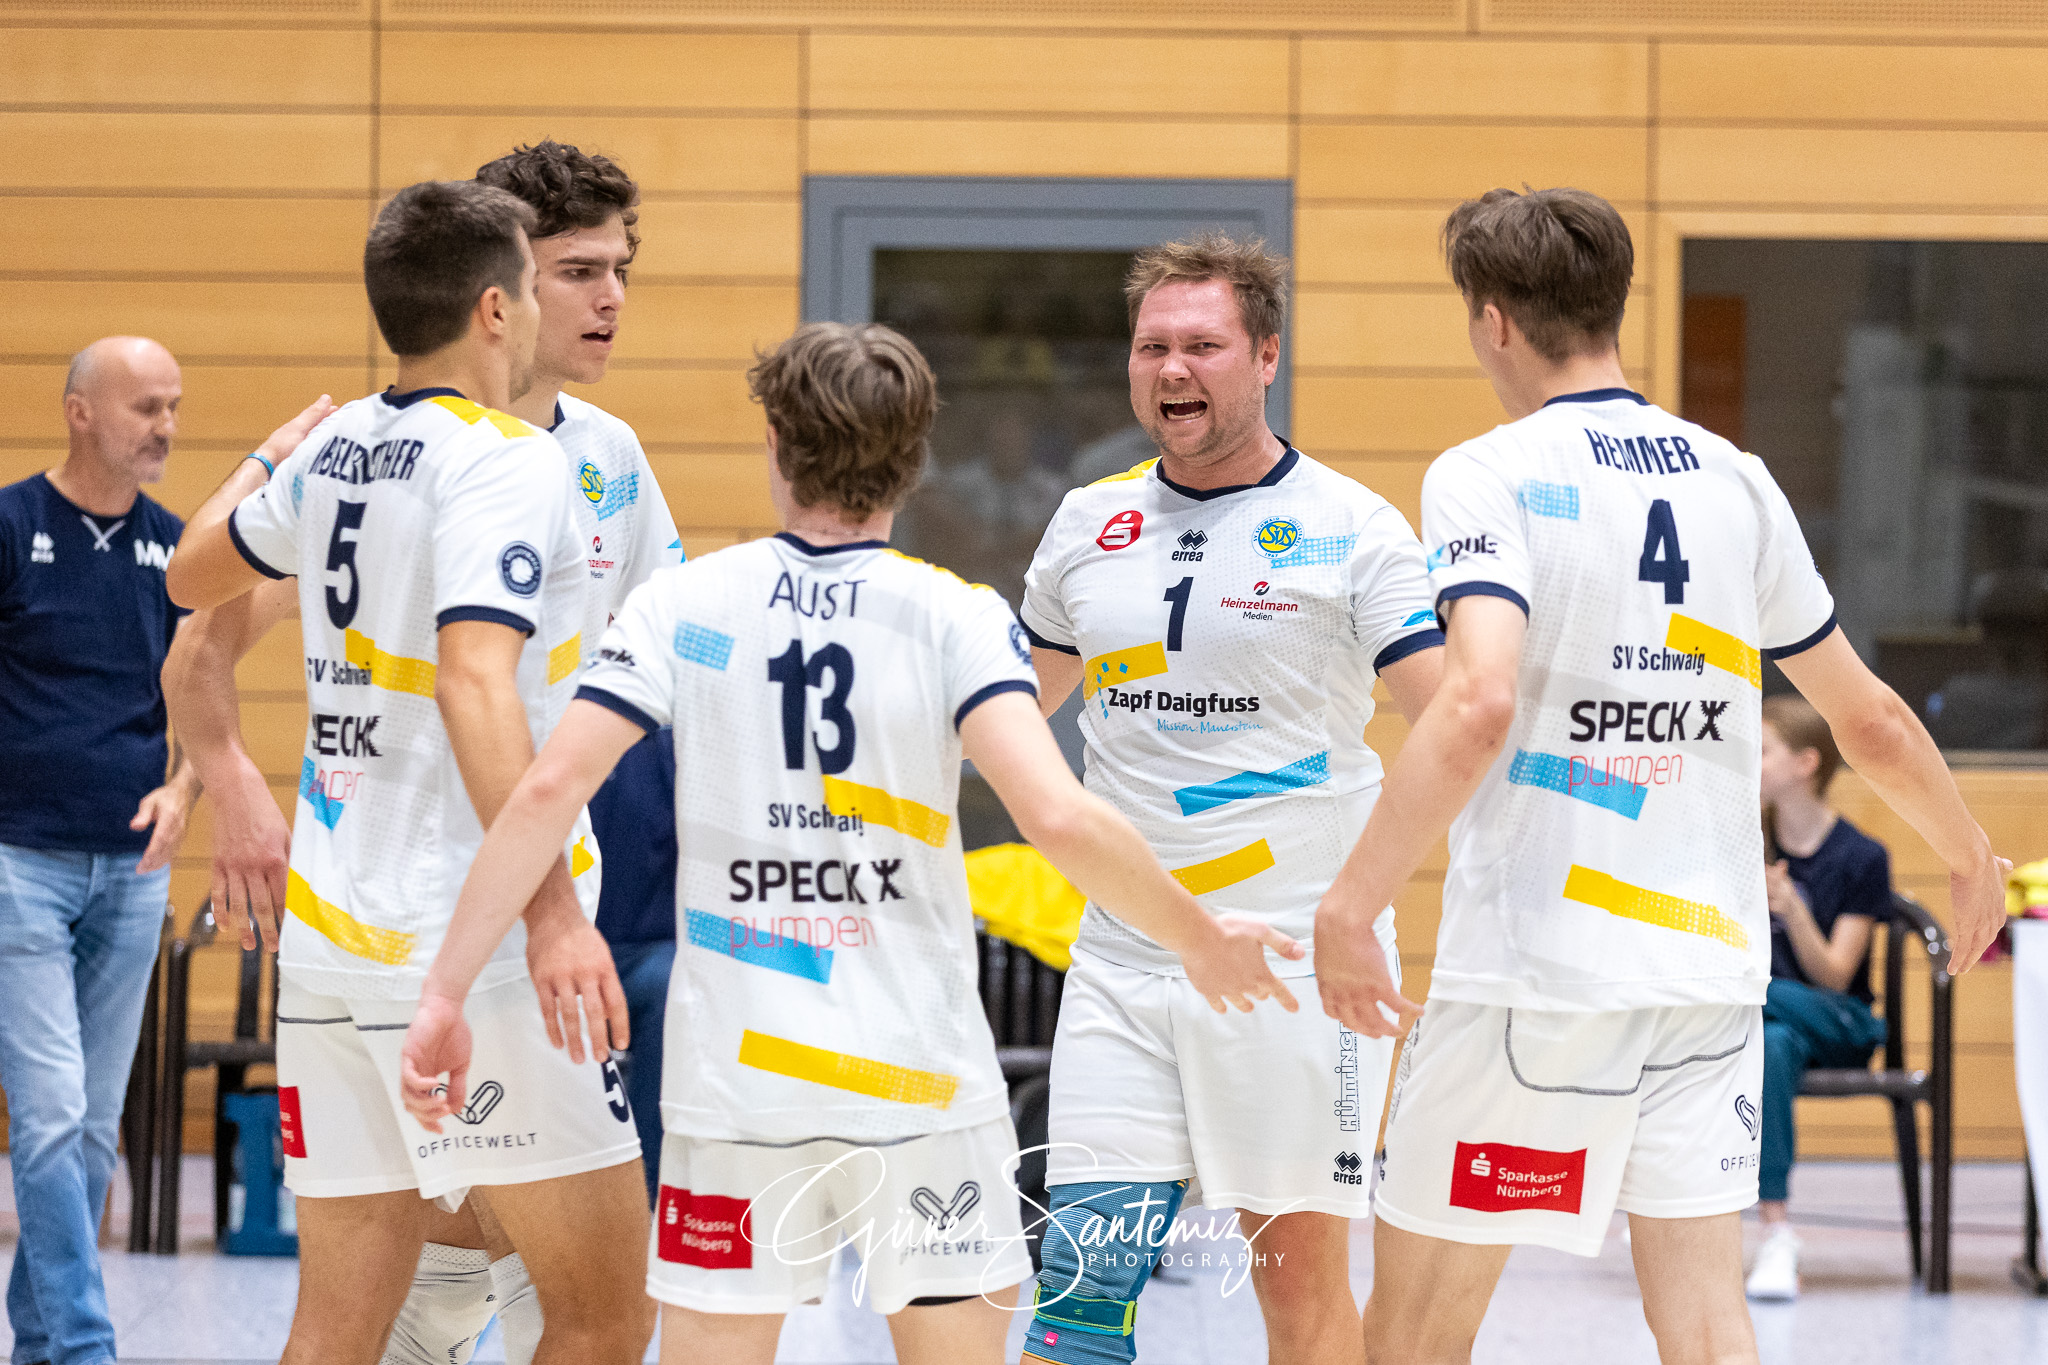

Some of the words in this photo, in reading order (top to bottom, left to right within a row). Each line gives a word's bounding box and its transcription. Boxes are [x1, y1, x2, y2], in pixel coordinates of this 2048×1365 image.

[1583, 428, 1701, 475] HEMMER
[324, 499, 367, 630] 5
[1171, 550, 1204, 562] errea
[1638, 499, 1690, 605] 4
[768, 571, 867, 620] AUST
[1220, 597, 1299, 612] Heinzelmann
[1163, 576, 1194, 652] 1
[1242, 611, 1273, 620] Medien
[1612, 645, 1634, 669] SV
[1638, 646, 1706, 676] Schwaig
[767, 638, 857, 775] 13
[1107, 688, 1153, 712] Zapf
[1157, 692, 1260, 717] Daigfuss
[1569, 700, 1691, 742] SPECK
[1569, 754, 1684, 796] pumpen
[768, 803, 792, 828] SV
[729, 859, 868, 904] SPECK
[730, 915, 877, 959] pumpen
[417, 1132, 537, 1159] OFFICEWELT
[1333, 1171, 1362, 1185] errea
[1496, 1184, 1562, 1198] Nürnberg
[1497, 1167, 1568, 1183] Sparkasse
